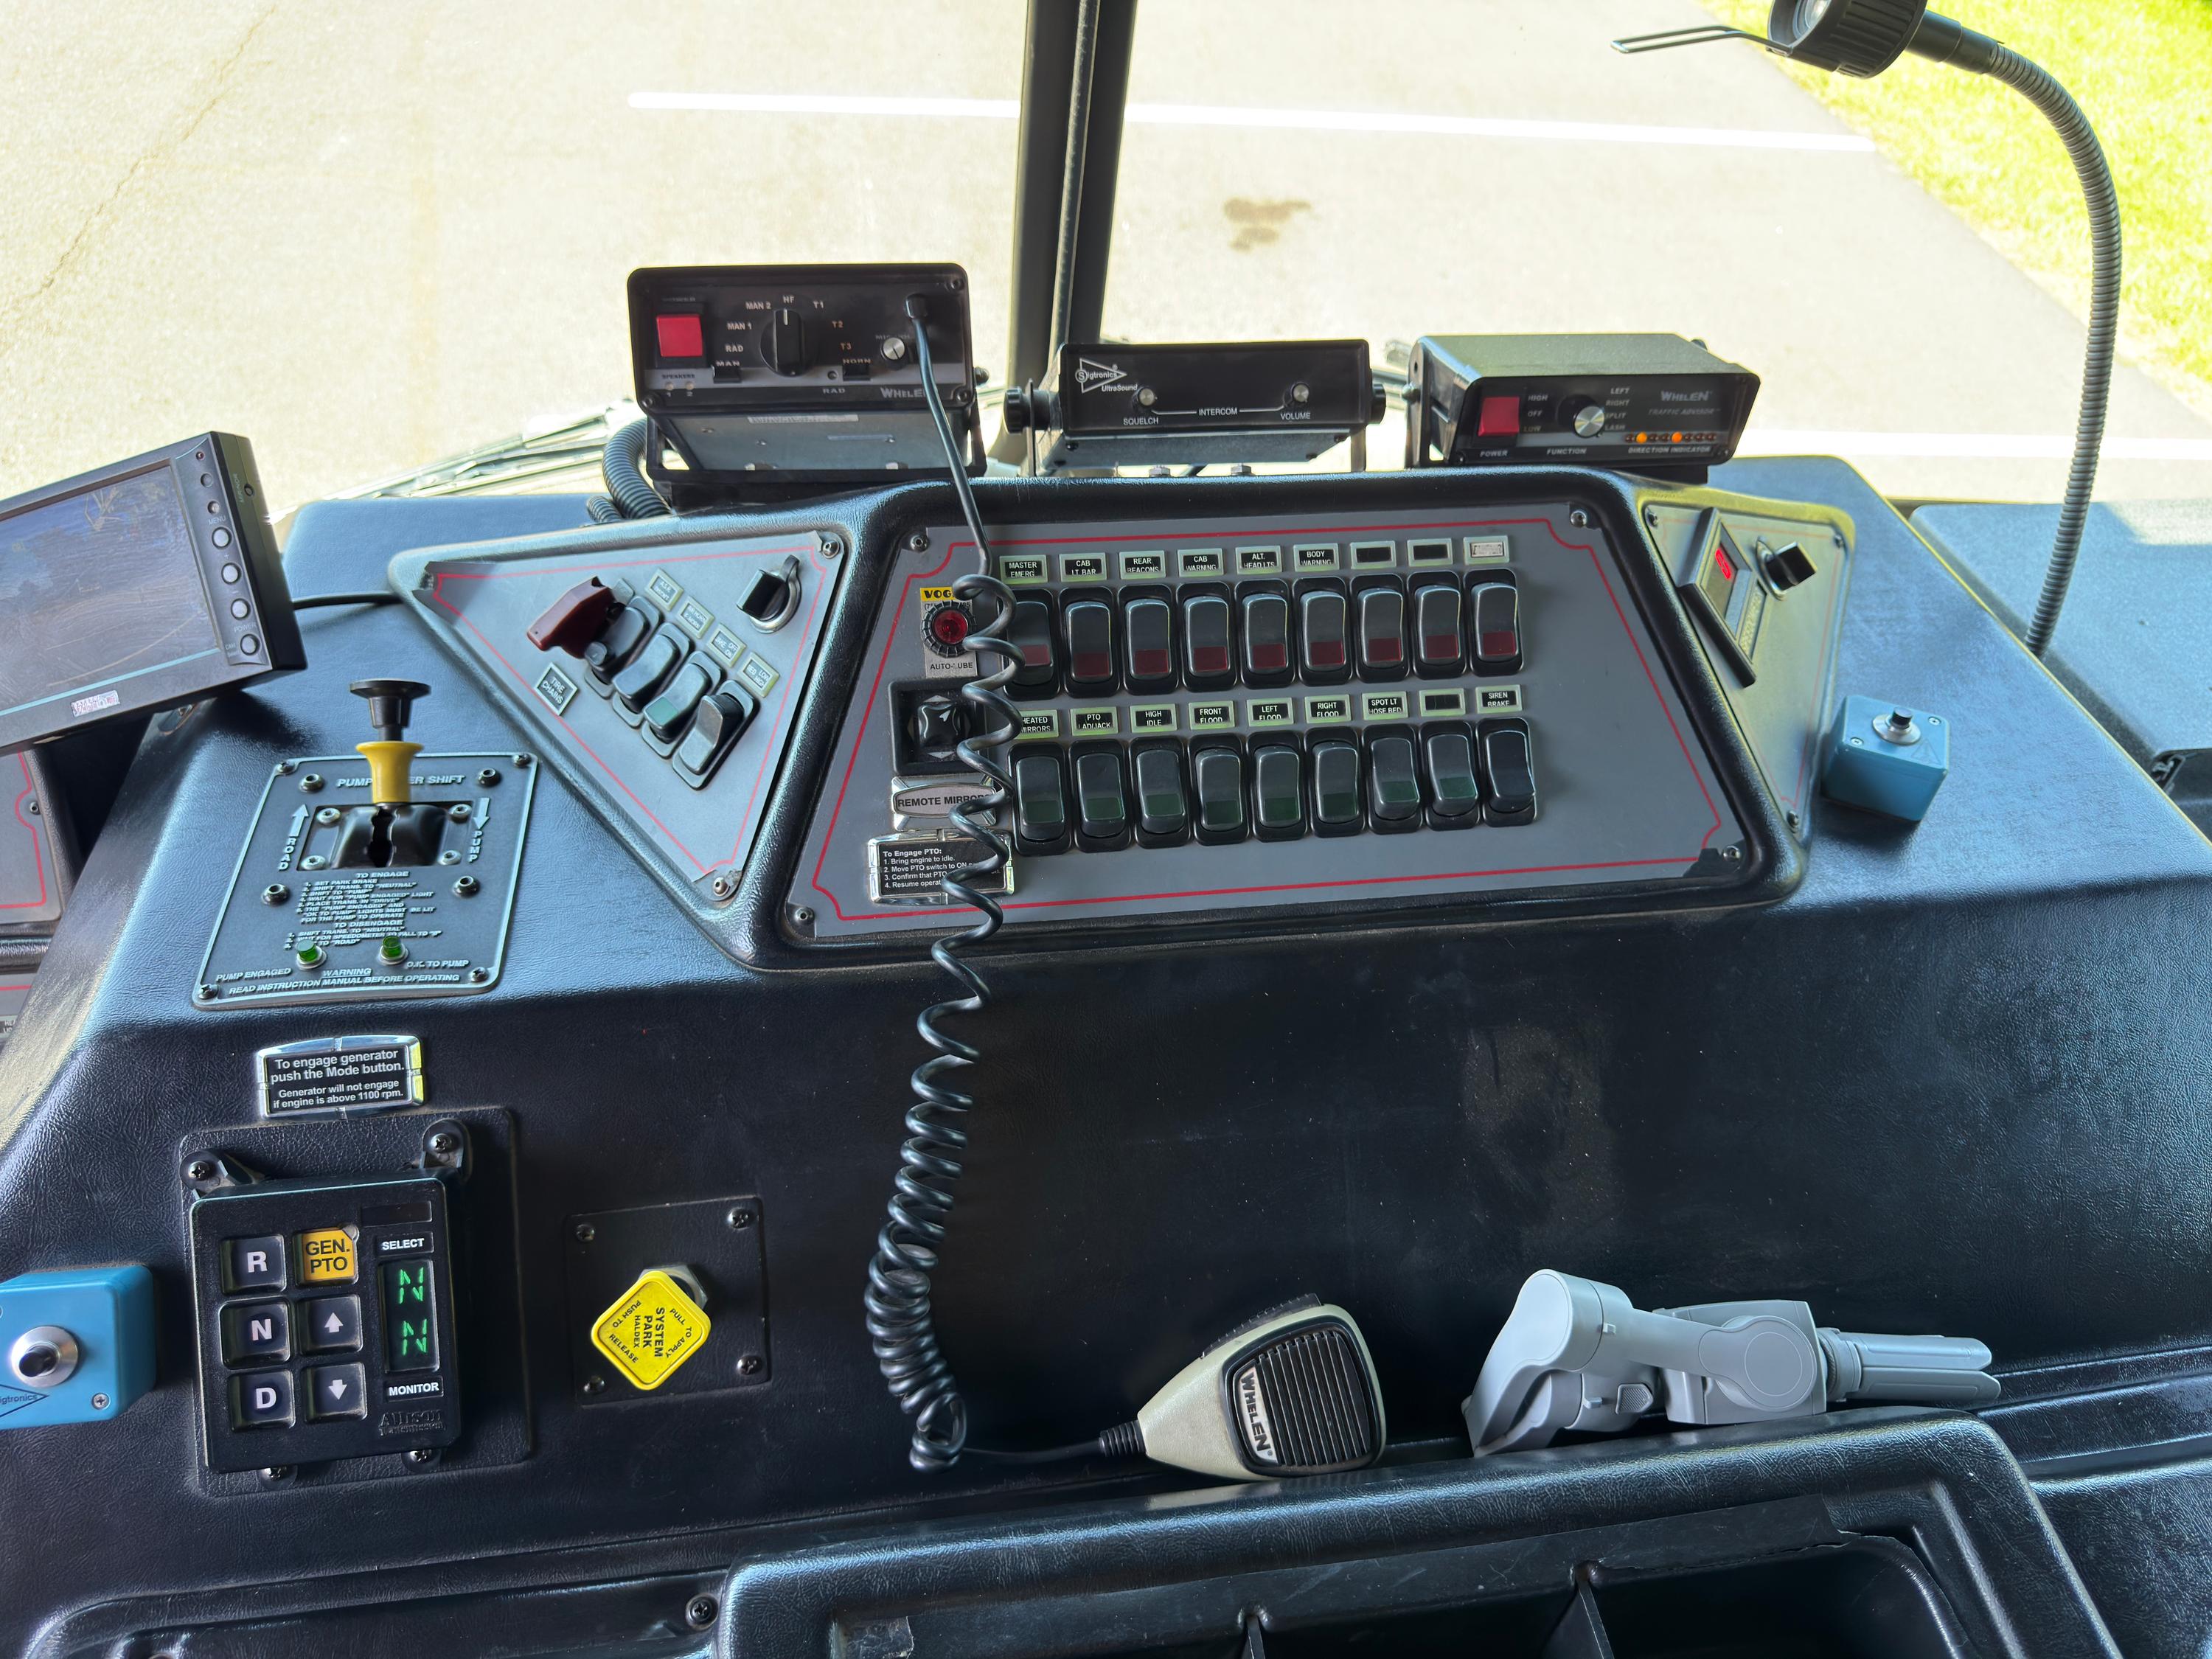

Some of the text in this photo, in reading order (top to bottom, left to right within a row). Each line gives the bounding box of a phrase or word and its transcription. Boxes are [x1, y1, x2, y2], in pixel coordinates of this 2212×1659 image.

[745, 302, 764, 310] MAN
[727, 322, 745, 330] MAN
[726, 344, 744, 352] RAD
[1078, 370, 1118, 380] Sigtronics
[880, 387, 926, 399] WHELE
[1101, 383, 1138, 392] UltraSound
[1660, 391, 1709, 401] WHELEN
[1198, 407, 1238, 416] INTERCOM
[1280, 412, 1311, 420] VOLUME
[1123, 417, 1159, 425] SQUELCH
[1671, 445, 1711, 453] INDICATOR
[1306, 550, 1325, 558] BODY
[1009, 561, 1037, 569] MASTER
[1133, 557, 1152, 566] REAR
[1186, 563, 1217, 571] WARNING
[924, 589, 952, 598] VOG
[930, 662, 973, 670] AUTO-UBE
[552, 676, 566, 694] TIRE
[542, 681, 563, 704] CHAINS
[1371, 698, 1388, 706] SPOT
[1200, 708, 1222, 716] FRONT
[337, 778, 372, 787] PUMP
[428, 775, 465, 785] SHIFT
[897, 796, 941, 807] REMOTE
[442, 959, 469, 967] PUMP
[216, 967, 292, 982] PUMP ENGAGED
[323, 968, 372, 977] WARNING
[229, 974, 460, 995] READ INSTRUCTION MANUAL BEFORE OPERATING
[275, 1050, 399, 1070] To engage generator
[270, 1062, 405, 1085] push the Mode button.
[279, 1080, 400, 1098] Generator will not engage
[273, 1090, 404, 1109] if engine is above 1100 rpm.
[305, 1239, 350, 1256] GEN.
[382, 1238, 425, 1250] SELECT
[246, 1251, 268, 1273] R
[310, 1256, 348, 1274] PTO
[398, 1266, 425, 1304] N
[622, 1300, 642, 1319] PUSH
[251, 1318, 273, 1341] N
[642, 1315, 653, 1349] PARK
[654, 1307, 665, 1357] SYSTEM
[665, 1308, 692, 1358] PULL TO APPLY
[402, 1318, 428, 1356] N
[609, 1334, 639, 1363] RELEASE
[389, 1381, 439, 1397] MONITOR
[255, 1387, 277, 1409] D
[1241, 1371, 1271, 1452] WHELEN
